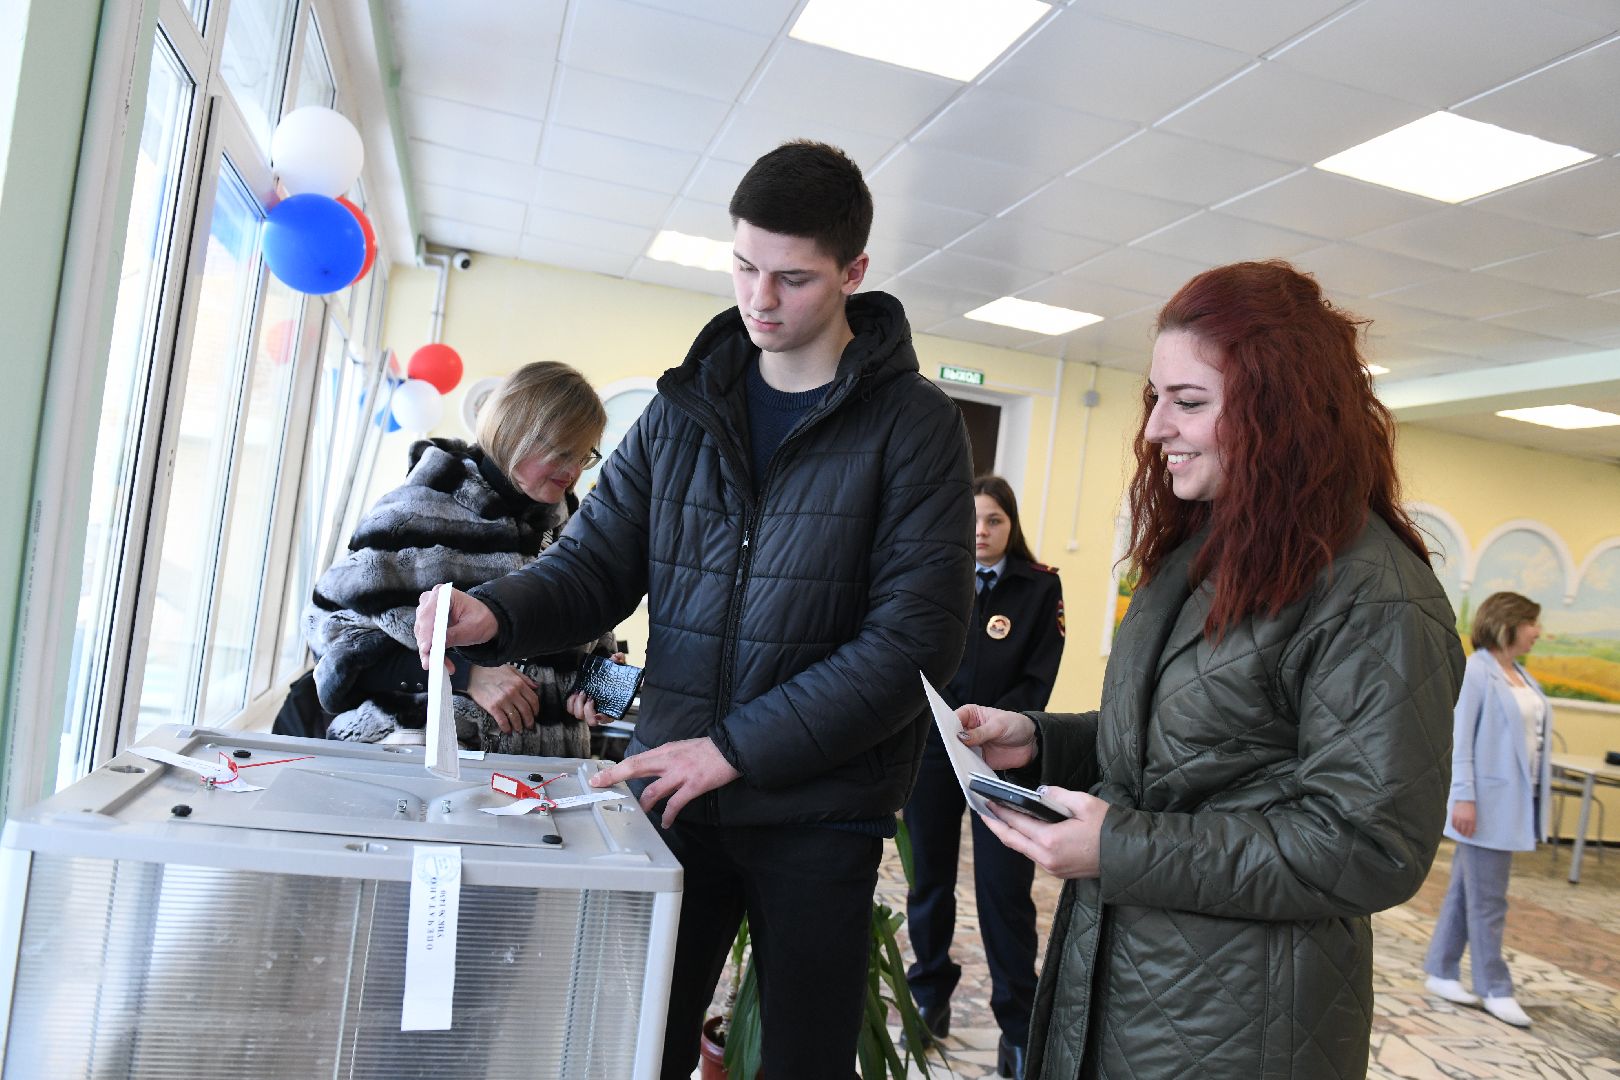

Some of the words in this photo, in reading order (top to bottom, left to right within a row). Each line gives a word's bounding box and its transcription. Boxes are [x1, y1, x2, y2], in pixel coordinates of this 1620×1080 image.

[943, 368, 981, 384] ВЫХОД
[426, 876, 437, 950] ОПЕЧАТАНО
[437, 920, 446, 938] УИК
